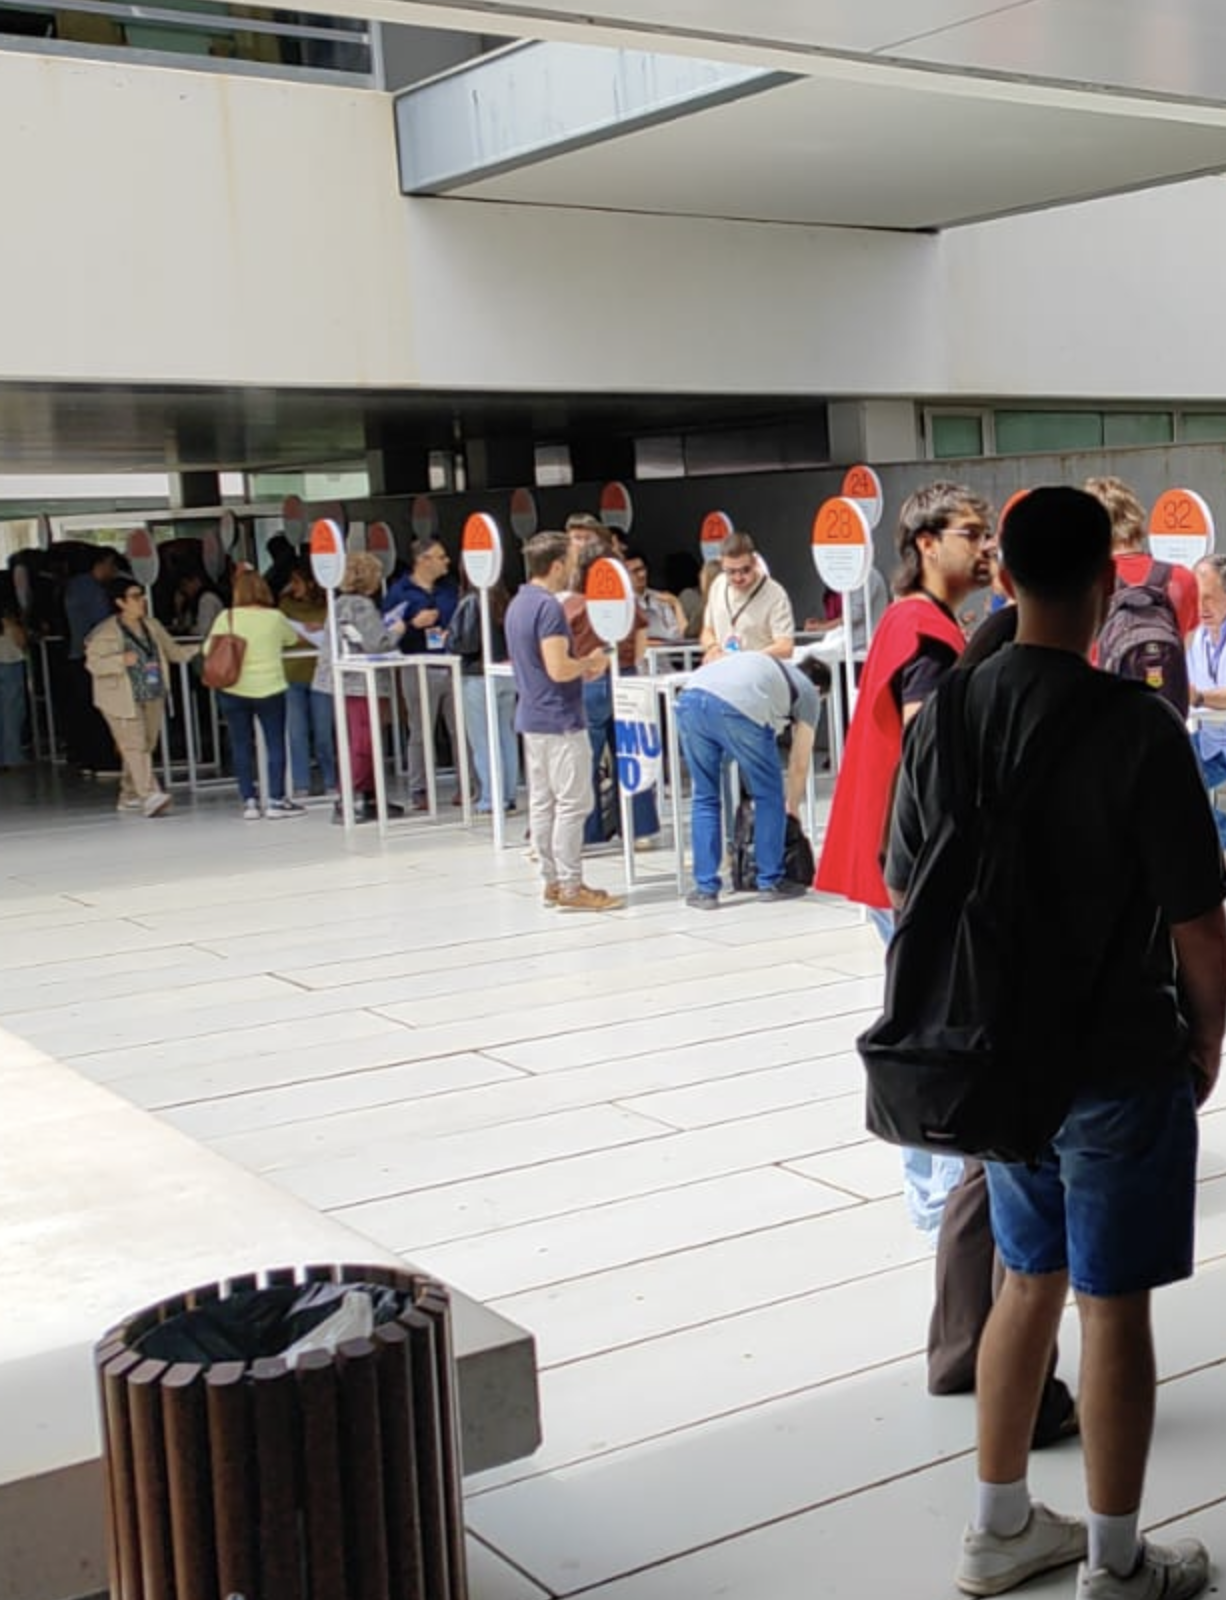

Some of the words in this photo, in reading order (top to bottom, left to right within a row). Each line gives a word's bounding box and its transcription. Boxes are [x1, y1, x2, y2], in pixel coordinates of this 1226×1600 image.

[851, 473, 869, 496] 24
[826, 509, 853, 538] 28
[1163, 499, 1192, 529] 32
